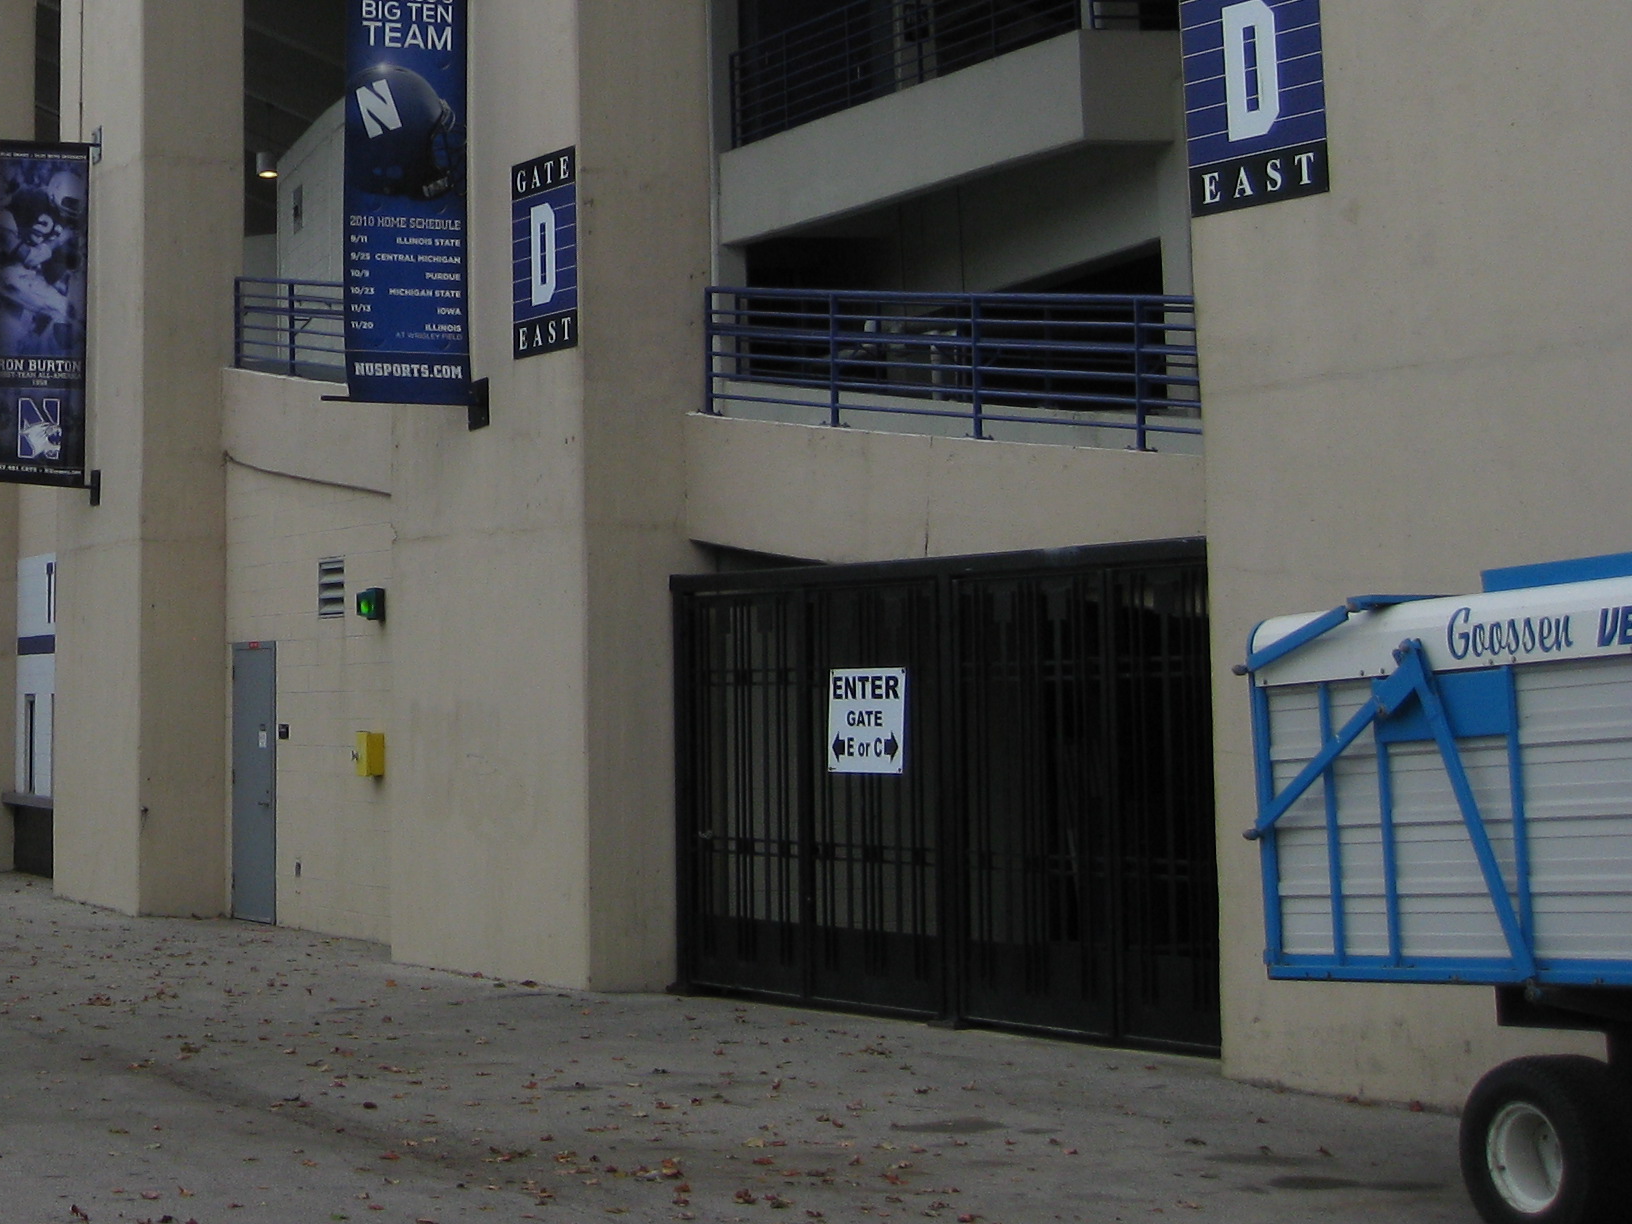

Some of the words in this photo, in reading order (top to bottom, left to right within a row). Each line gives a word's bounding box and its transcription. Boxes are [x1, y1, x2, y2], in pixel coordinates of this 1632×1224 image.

[362, 0, 401, 21] BIG
[407, 2, 453, 24] TEN
[362, 21, 452, 51] TEAM
[356, 78, 402, 139] N
[516, 155, 569, 193] GATE
[1201, 152, 1315, 205] EAST
[350, 215, 374, 227] 2010
[377, 216, 407, 228] HOME
[409, 218, 461, 231] SCHEDULE
[396, 237, 432, 246] ILLINOIS
[435, 238, 461, 247] STATE
[375, 253, 416, 262] CENTRAL
[418, 255, 461, 264] MICHIGAN
[530, 202, 556, 307] D
[425, 272, 461, 281] PURDUE
[389, 288, 432, 297] MICHIGAN
[435, 289, 461, 298] STATE
[437, 307, 462, 315] IOWA
[351, 321, 374, 329] 11/20
[425, 324, 462, 332] ILLINOIS
[519, 316, 571, 351] EAST
[29, 359, 82, 372] BURTON
[354, 362, 463, 379] NUSPORTS.COM
[1447, 606, 1573, 660] Goossen
[832, 675, 899, 700] ENTER
[846, 710, 883, 727] GATE
[847, 737, 855, 757] E
[858, 742, 871, 757] or
[874, 737, 883, 757] C
